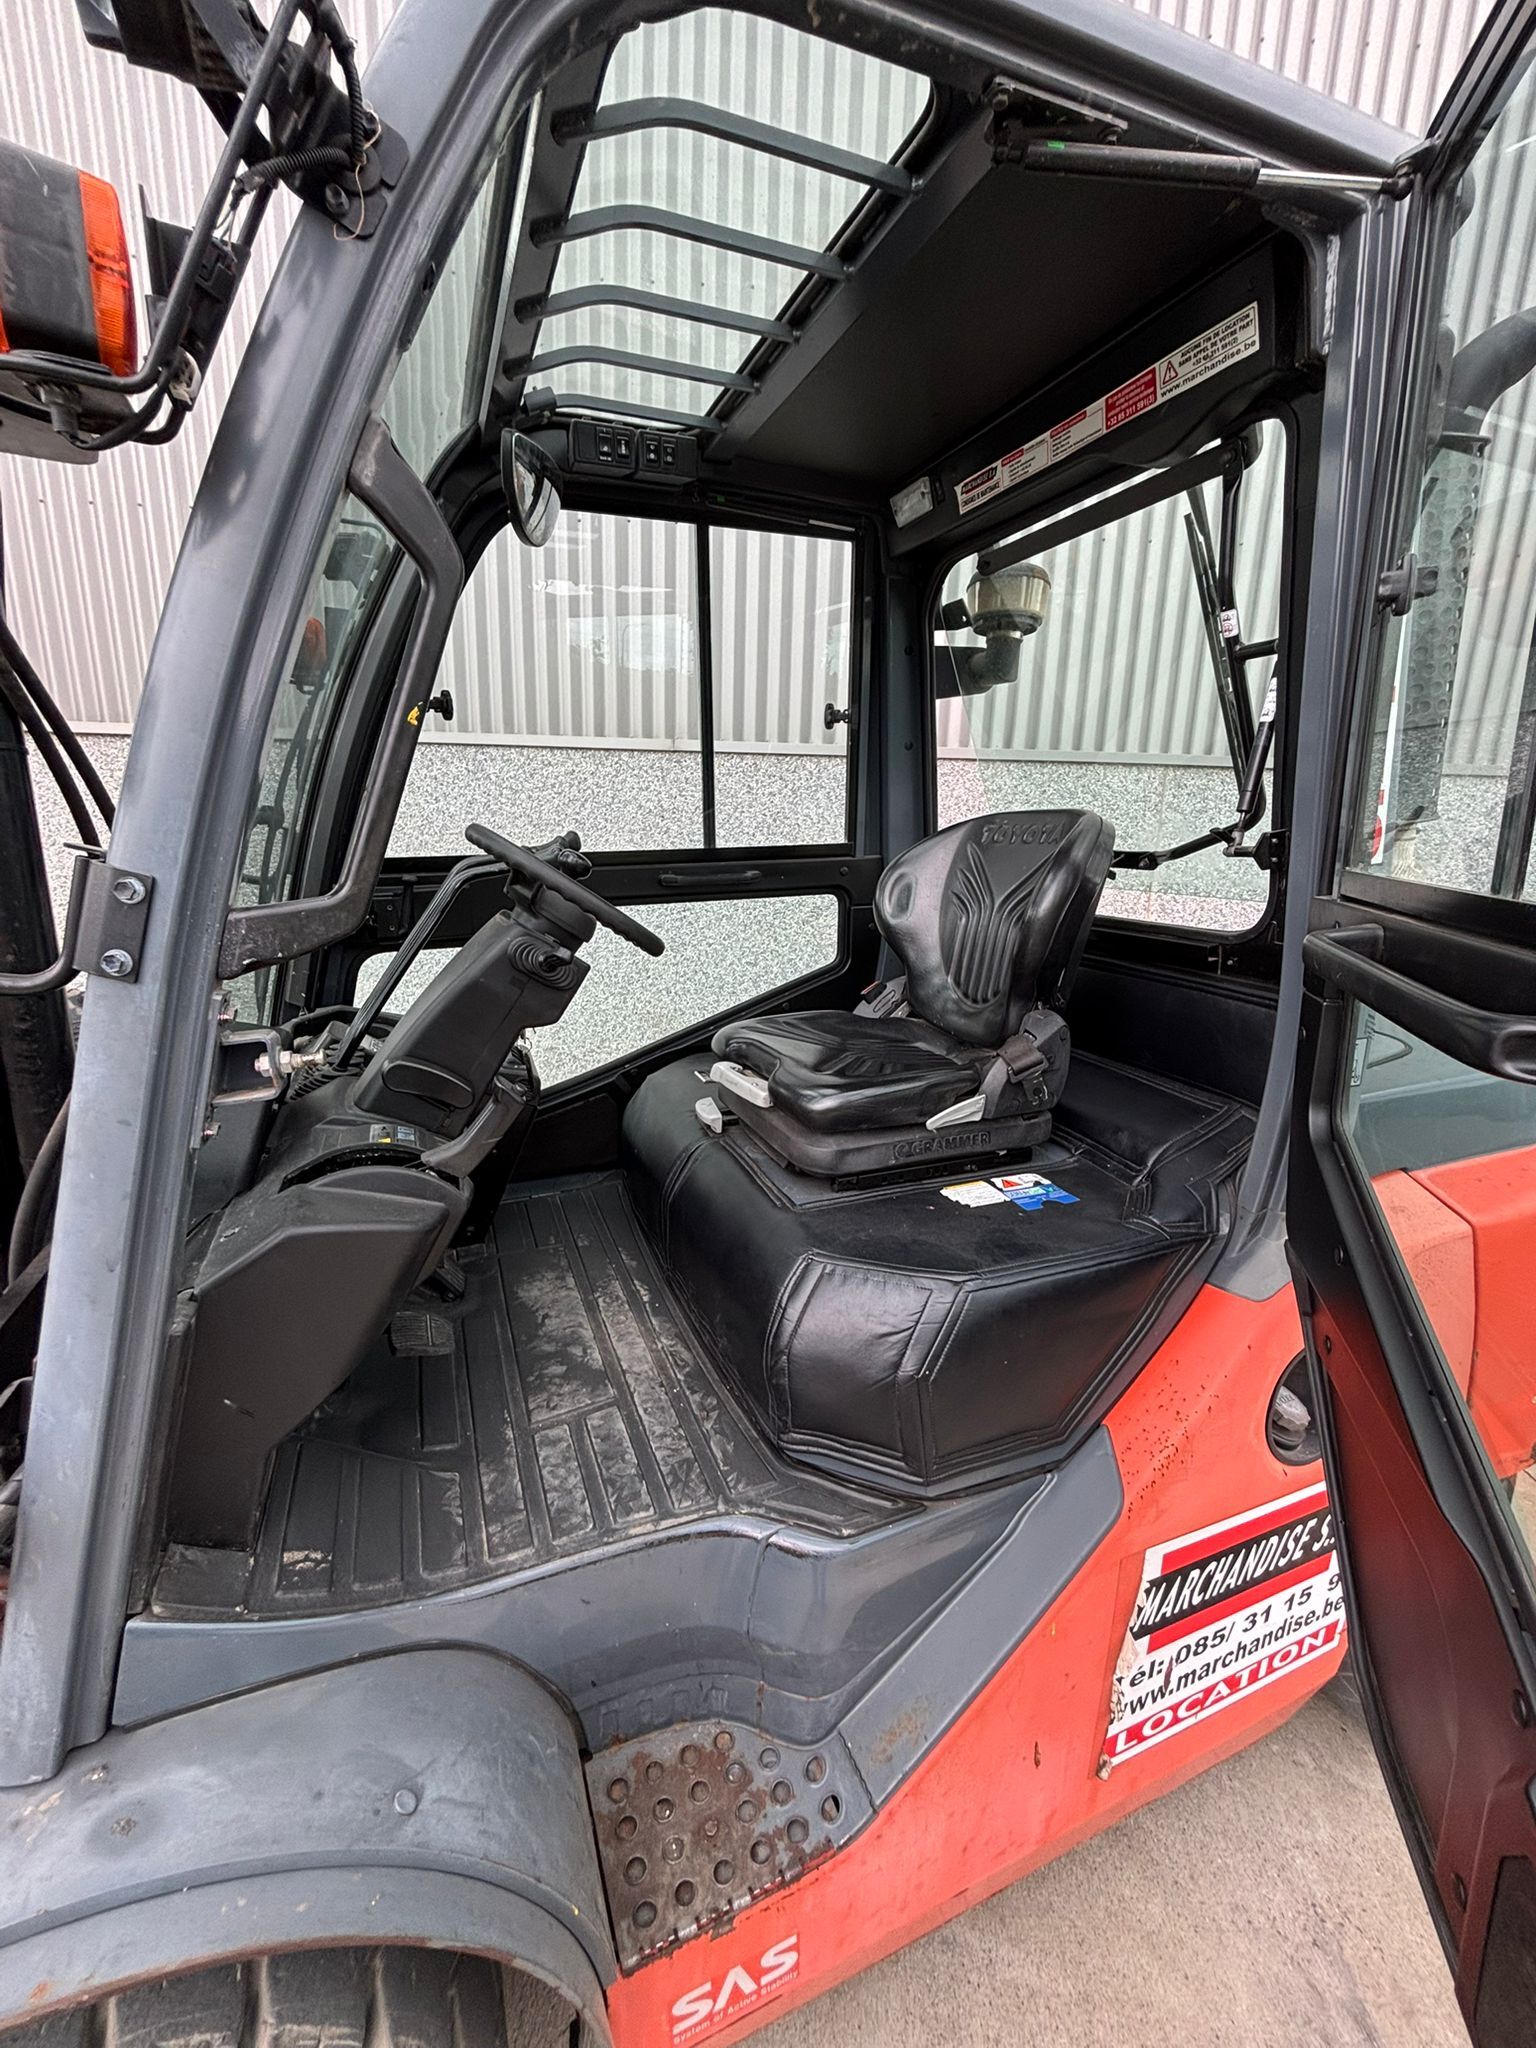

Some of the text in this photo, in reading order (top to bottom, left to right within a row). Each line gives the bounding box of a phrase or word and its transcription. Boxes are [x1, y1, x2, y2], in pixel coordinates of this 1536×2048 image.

[1219, 330, 1238, 346] VOTRE
[1239, 319, 1254, 333] PART
[1221, 312, 1251, 334] LOCATION
[1160, 339, 1257, 398] www.marchandise.be
[981, 821, 1065, 846] TOYOTA
[911, 1131, 992, 1154] GRAMMER
[1133, 1517, 1317, 1632] MARCHANDISE
[1242, 1604, 1272, 1633] 31
[1283, 1584, 1313, 1611] 15
[1115, 1628, 1325, 1752] LOCATION
[671, 1933, 799, 2036] SAS
[673, 1969, 799, 2045] System of Active Stability
